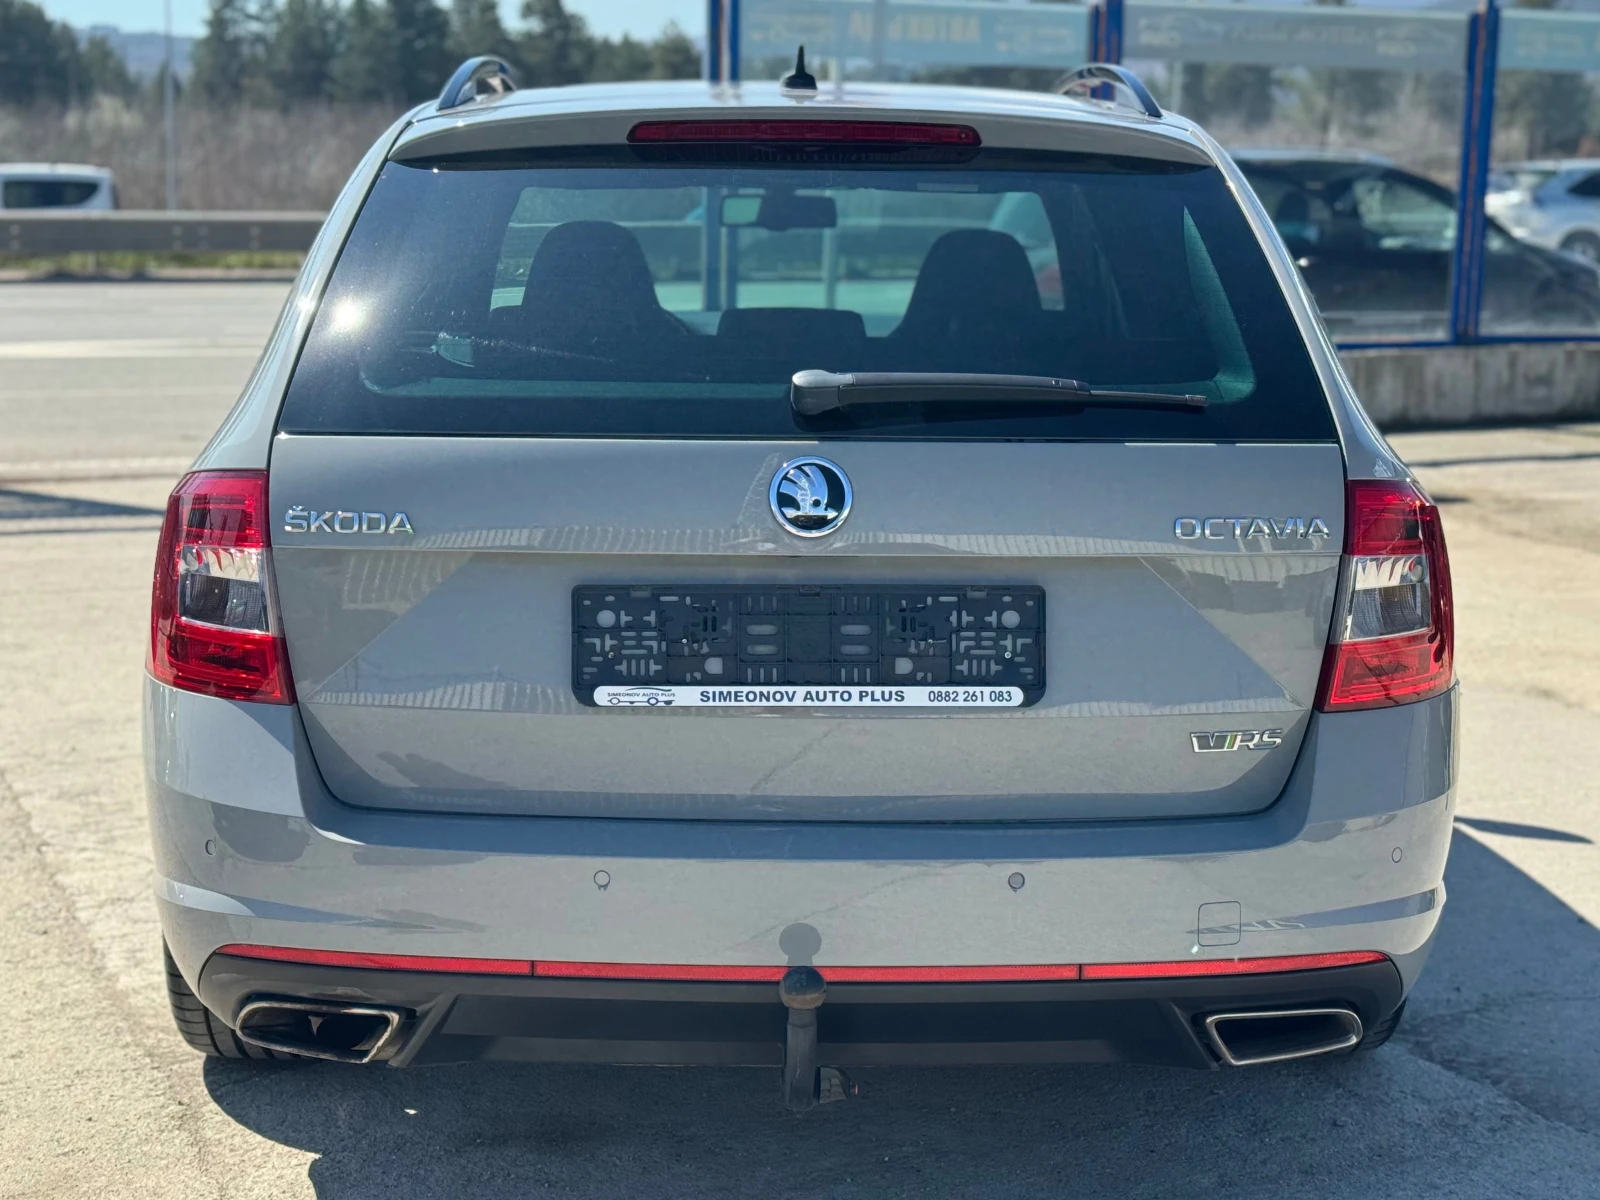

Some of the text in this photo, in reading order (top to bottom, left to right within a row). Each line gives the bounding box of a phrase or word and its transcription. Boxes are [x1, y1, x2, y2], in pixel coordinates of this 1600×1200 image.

[284, 505, 415, 534] ŠKODA
[1174, 517, 1331, 540] OCTAVIA
[700, 690, 905, 703] SIMEONOV AUTO PLUS
[928, 690, 1013, 703] 0882 261 083
